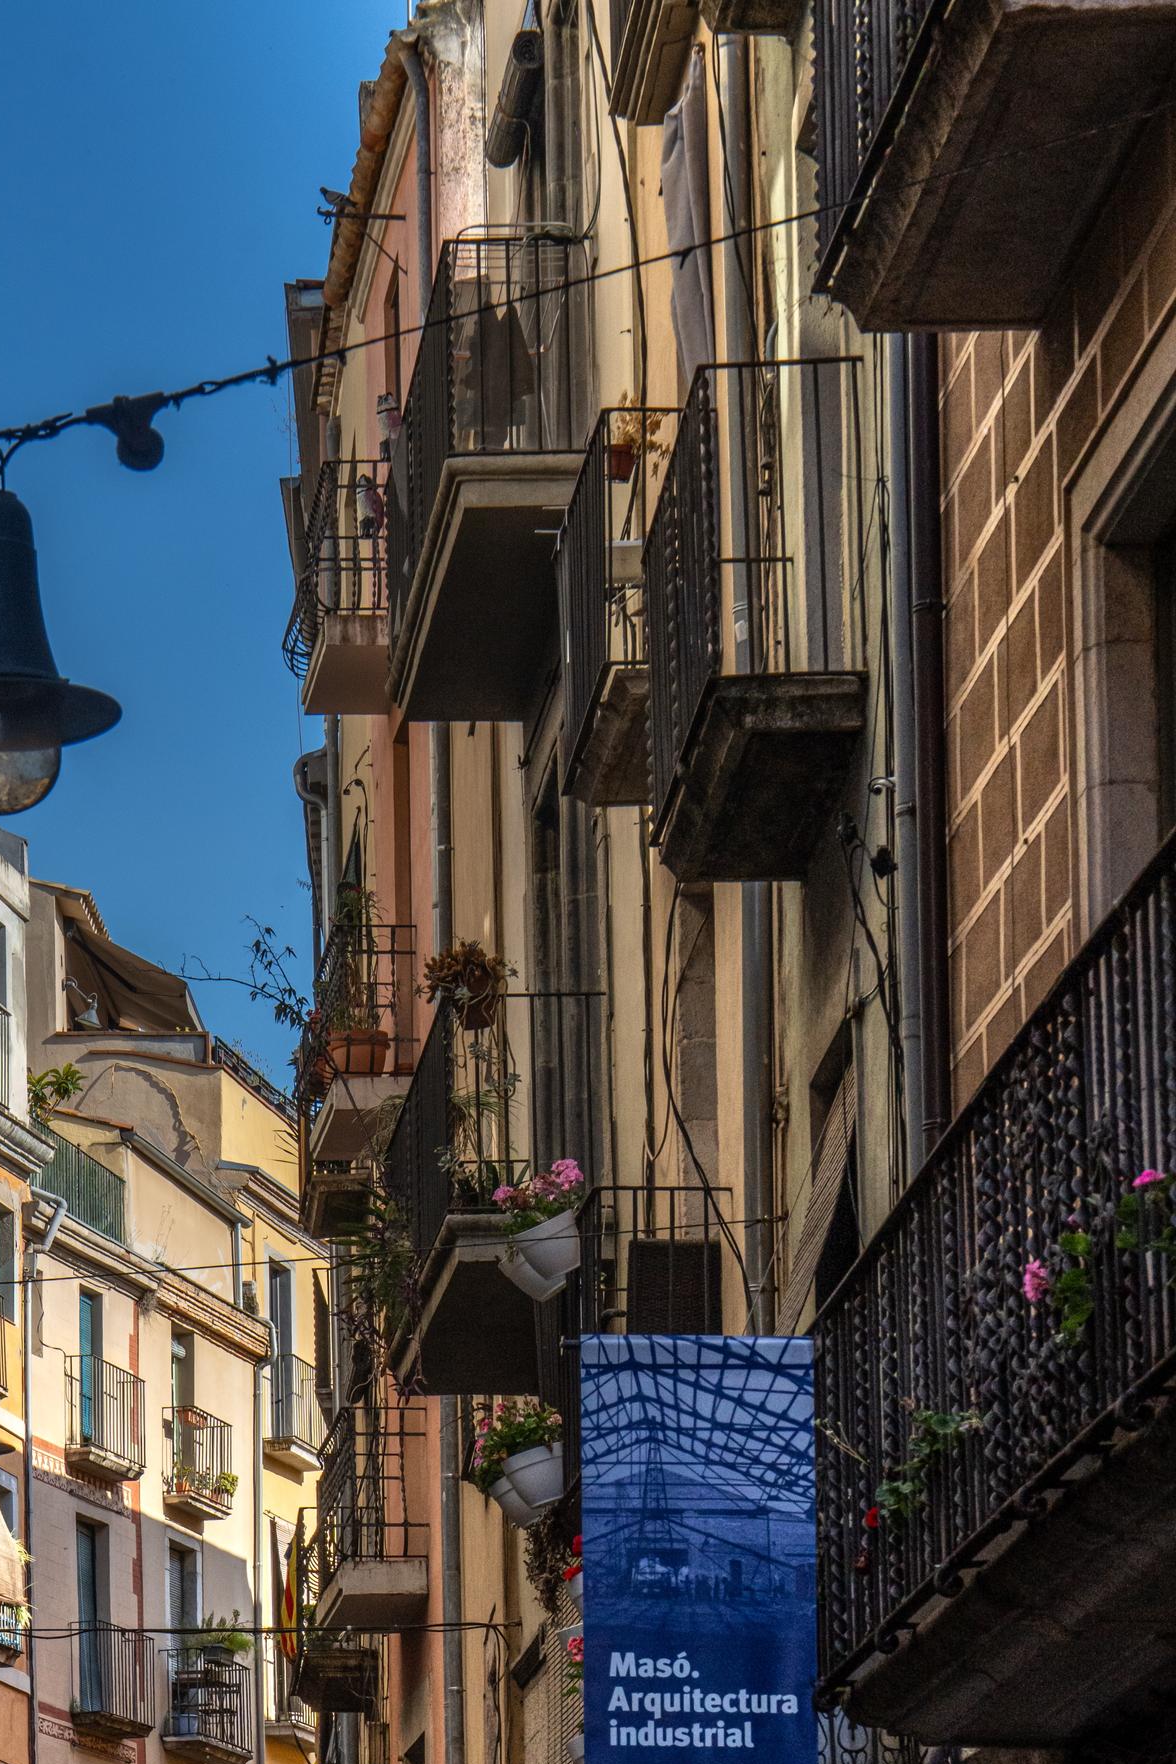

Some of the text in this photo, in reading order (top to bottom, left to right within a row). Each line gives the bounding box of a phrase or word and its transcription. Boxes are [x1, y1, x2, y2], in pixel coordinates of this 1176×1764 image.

[609, 1651, 700, 1679] Masó.
[607, 1685, 799, 1719] Arquitectura
[609, 1718, 755, 1748] industrial
